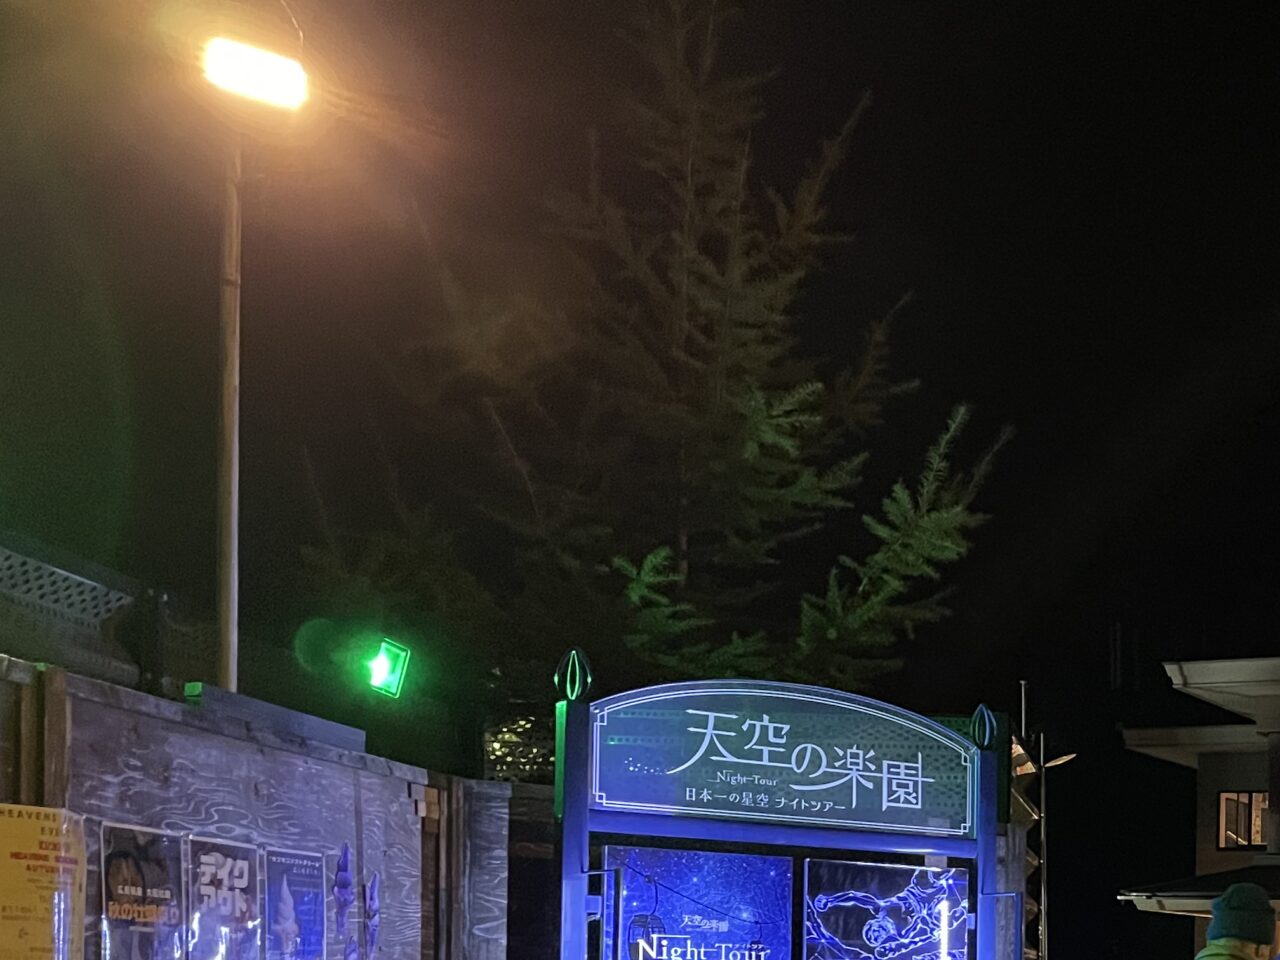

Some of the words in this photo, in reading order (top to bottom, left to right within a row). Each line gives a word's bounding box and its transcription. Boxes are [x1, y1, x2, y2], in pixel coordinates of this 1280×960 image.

[665, 708, 936, 812] 天空の楽園
[707, 769, 749, 787] Night
[753, 775, 778, 787] Tour
[685, 788, 769, 808] 日本一の星空
[775, 796, 847, 812] ナイトツアー
[200, 852, 249, 890] テイク
[200, 886, 247, 917] アウト
